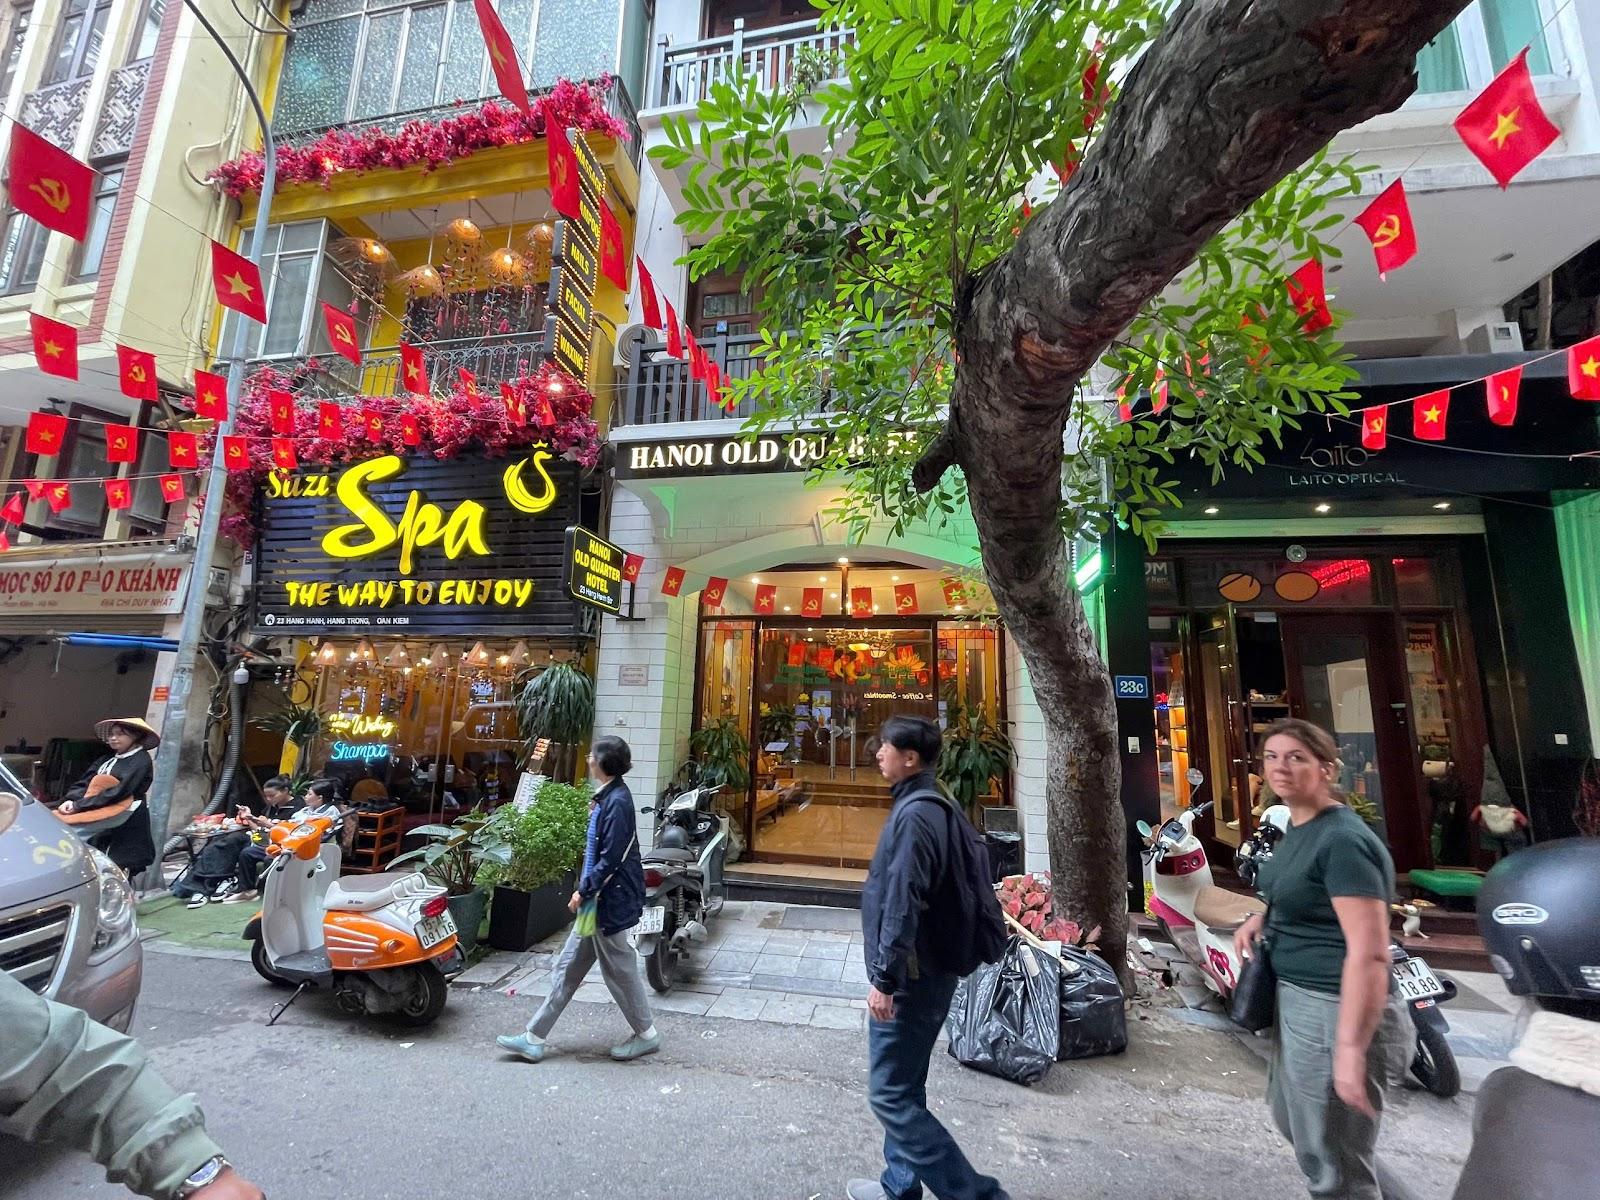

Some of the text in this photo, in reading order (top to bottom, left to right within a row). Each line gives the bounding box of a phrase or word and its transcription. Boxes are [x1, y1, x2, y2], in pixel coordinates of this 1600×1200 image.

[580, 199, 600, 239] AMPOO
[571, 244, 590, 276] NAILS
[565, 287, 587, 323] FACIAL
[560, 335, 584, 373] WAXING
[629, 443, 714, 470] HANOI
[721, 439, 779, 465] OLD
[1289, 472, 1405, 486] LAITO OPTICAL
[321, 455, 493, 575] Spa
[588, 538, 611, 561] HANOI
[54, 571, 76, 593] 10
[115, 561, 183, 593] KHÁNH
[574, 548, 621, 583] OLD QUARTER
[285, 579, 534, 608] THE WAY TO ENJOY
[586, 571, 608, 594] HOTEL
[276, 617, 285, 625] 23
[286, 617, 305, 625] HANG
[327, 617, 345, 625] HANG
[346, 617, 371, 625] TRONG,
[392, 617, 409, 625] KIEM
[331, 740, 387, 764] Shampoo
[422, 921, 455, 946] 091.16
[1400, 976, 1439, 997] 18.88
